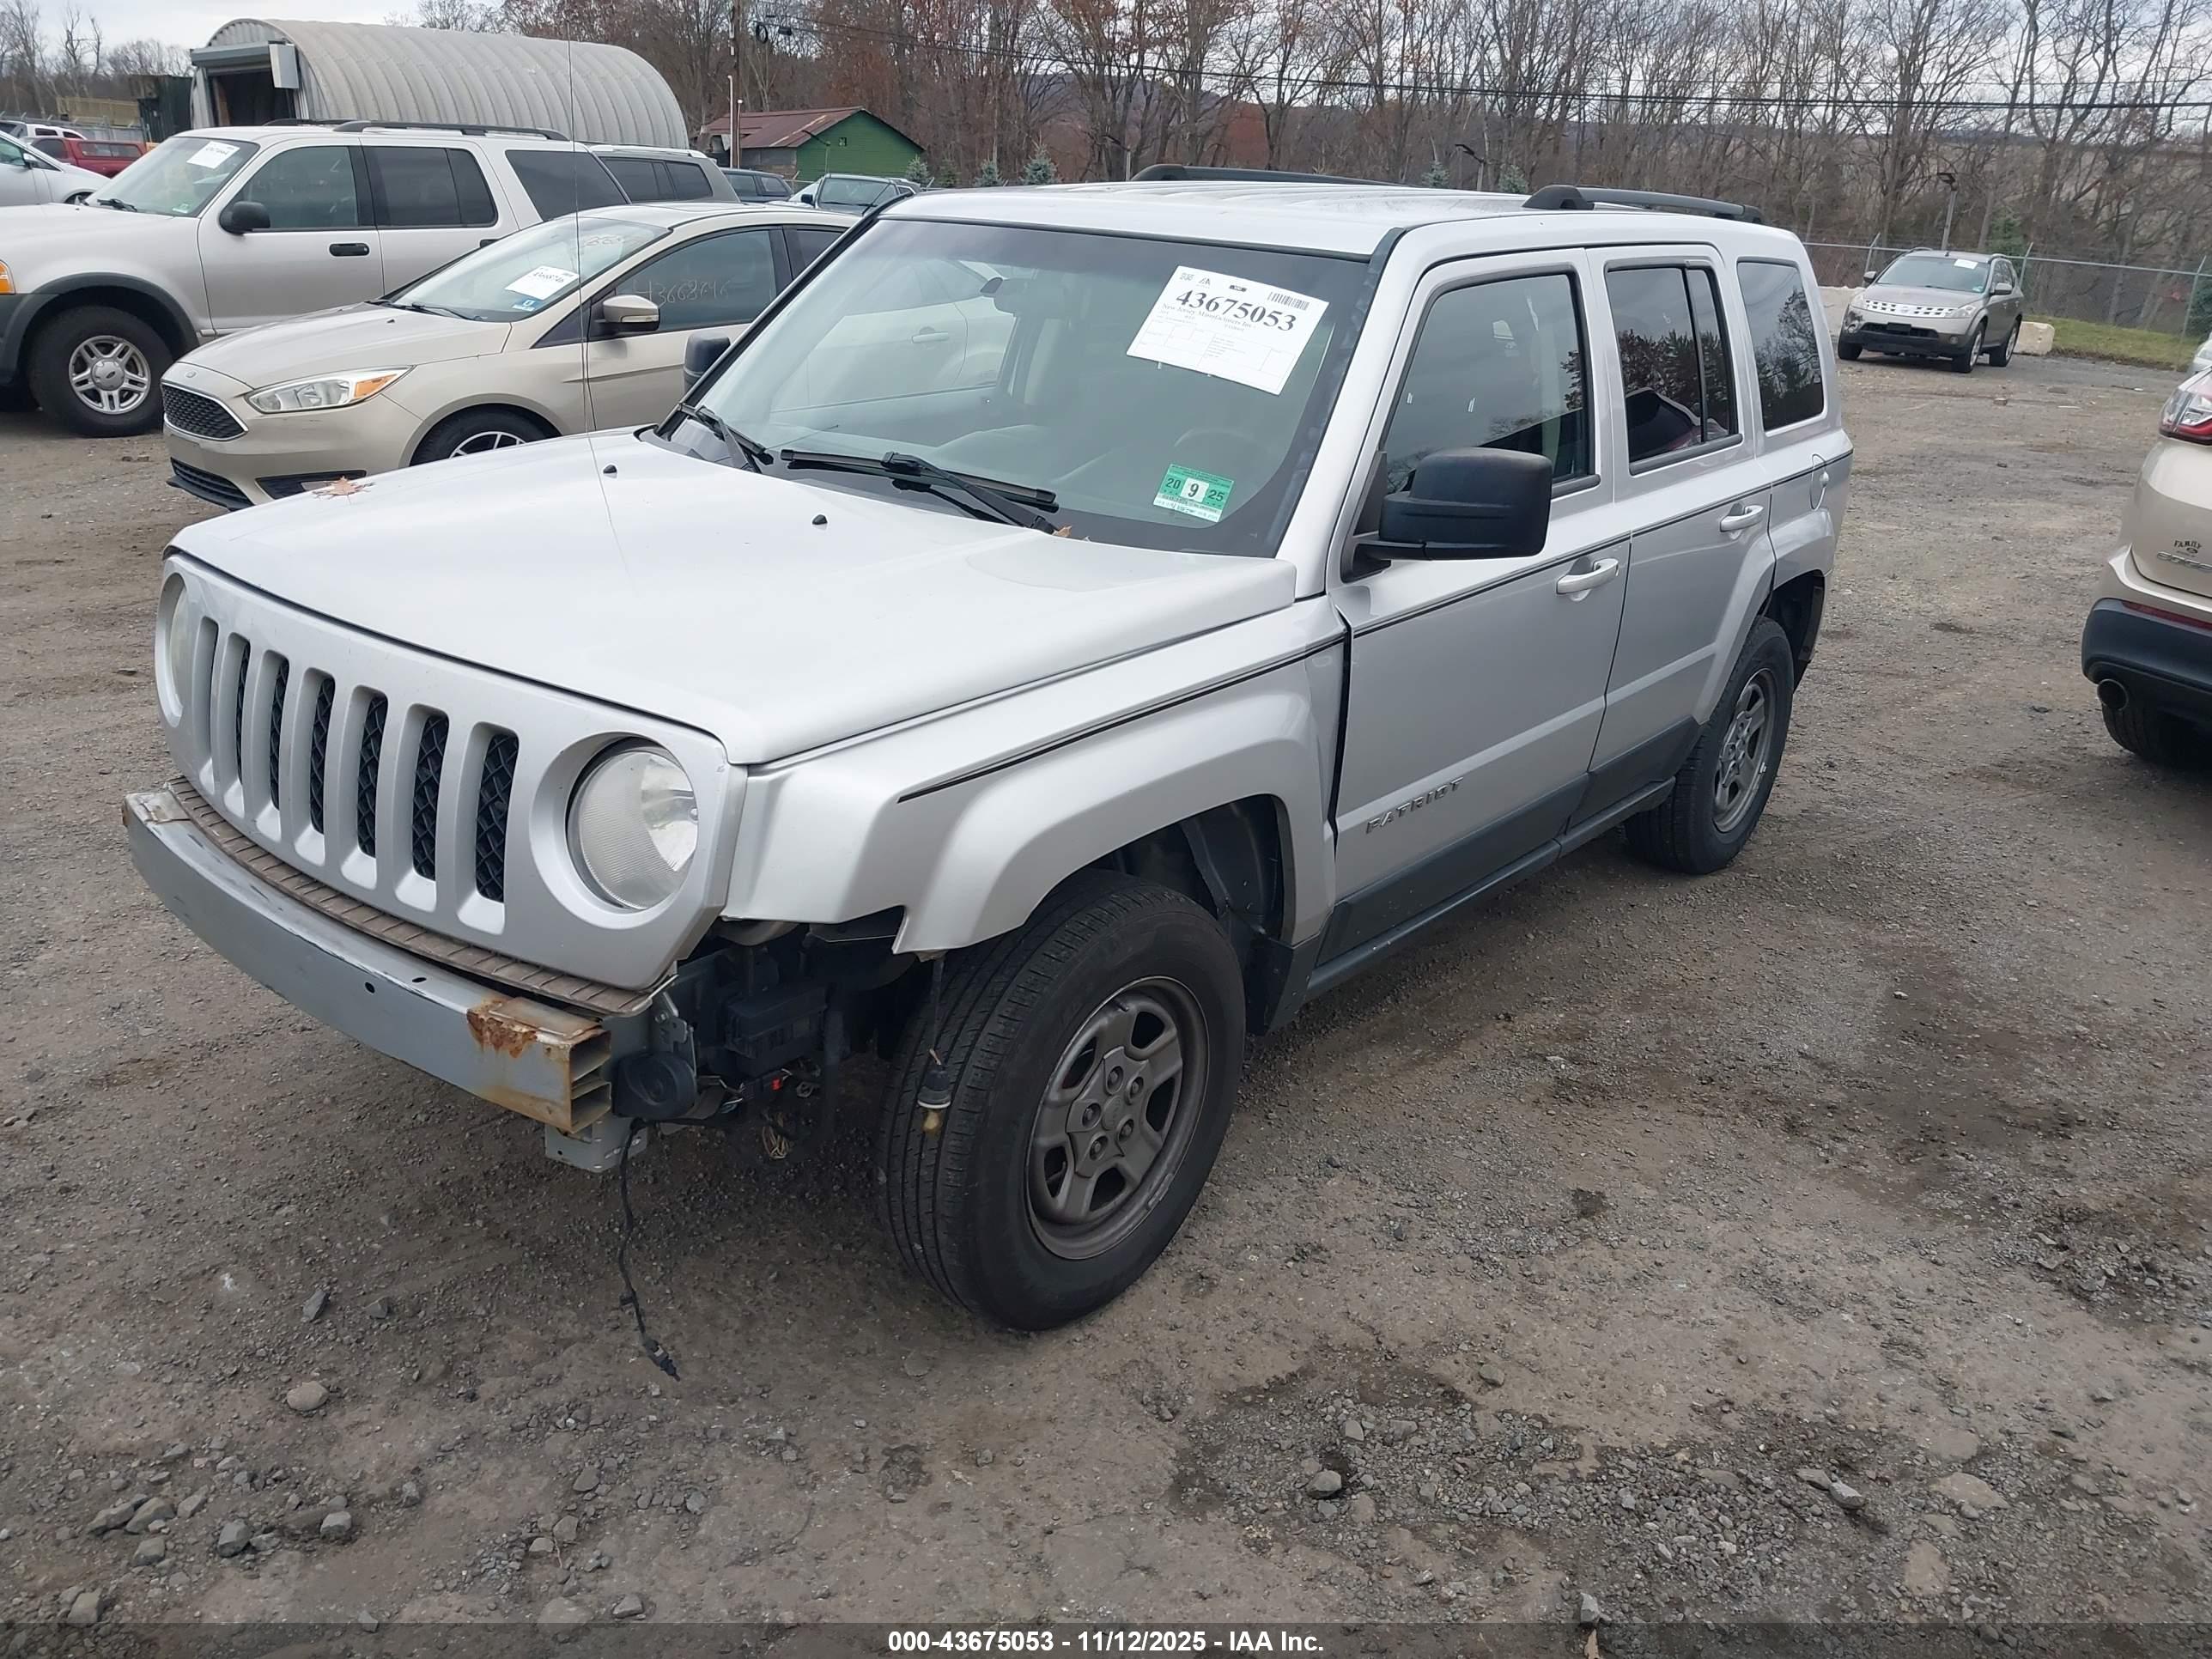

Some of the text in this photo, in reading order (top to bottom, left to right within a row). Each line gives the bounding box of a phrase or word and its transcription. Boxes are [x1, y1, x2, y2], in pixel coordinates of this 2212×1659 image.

[1176, 289, 1296, 331] 43675053
[1166, 477, 1225, 502] 20 9 25
[1365, 776, 1464, 835] PATRIOT
